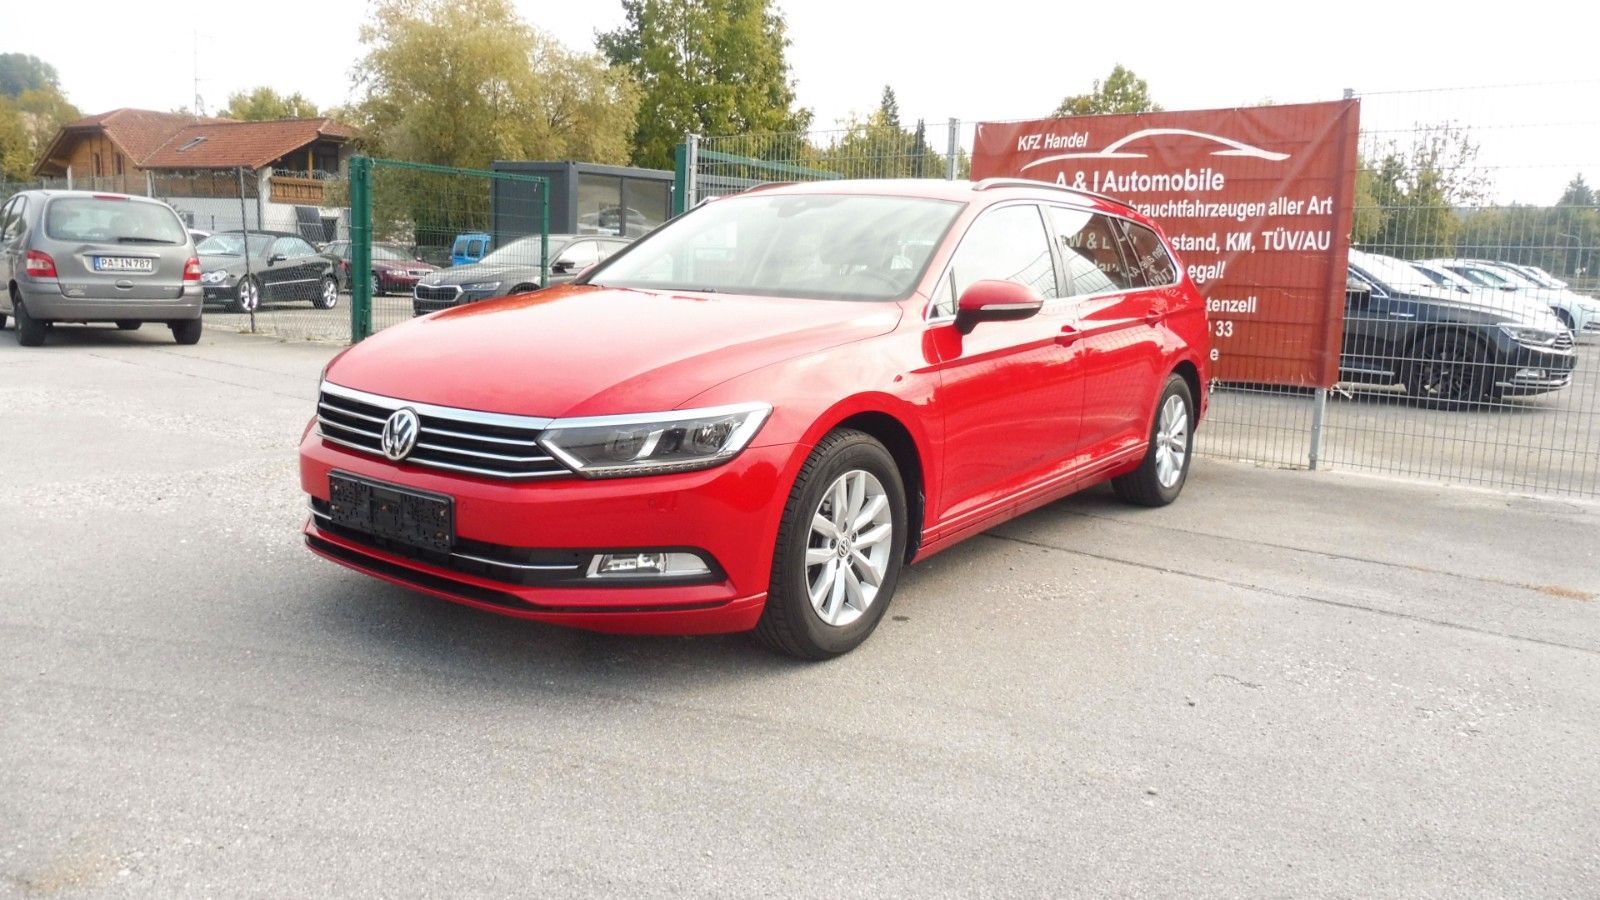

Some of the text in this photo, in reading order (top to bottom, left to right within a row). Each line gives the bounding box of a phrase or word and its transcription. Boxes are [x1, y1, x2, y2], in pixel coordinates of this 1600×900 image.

[1017, 132, 1089, 151] KFZ Handel
[1056, 171, 1067, 187] A
[1072, 171, 1087, 192] &
[1101, 168, 1225, 192] Automobile
[1268, 196, 1304, 216] aller
[1306, 195, 1333, 215] Art
[1168, 232, 1220, 254] stand,
[1226, 232, 1256, 253] KM,
[1262, 227, 1331, 251] TÜV/AU
[1187, 261, 1226, 284] egal!
[1215, 320, 1233, 337] 33
